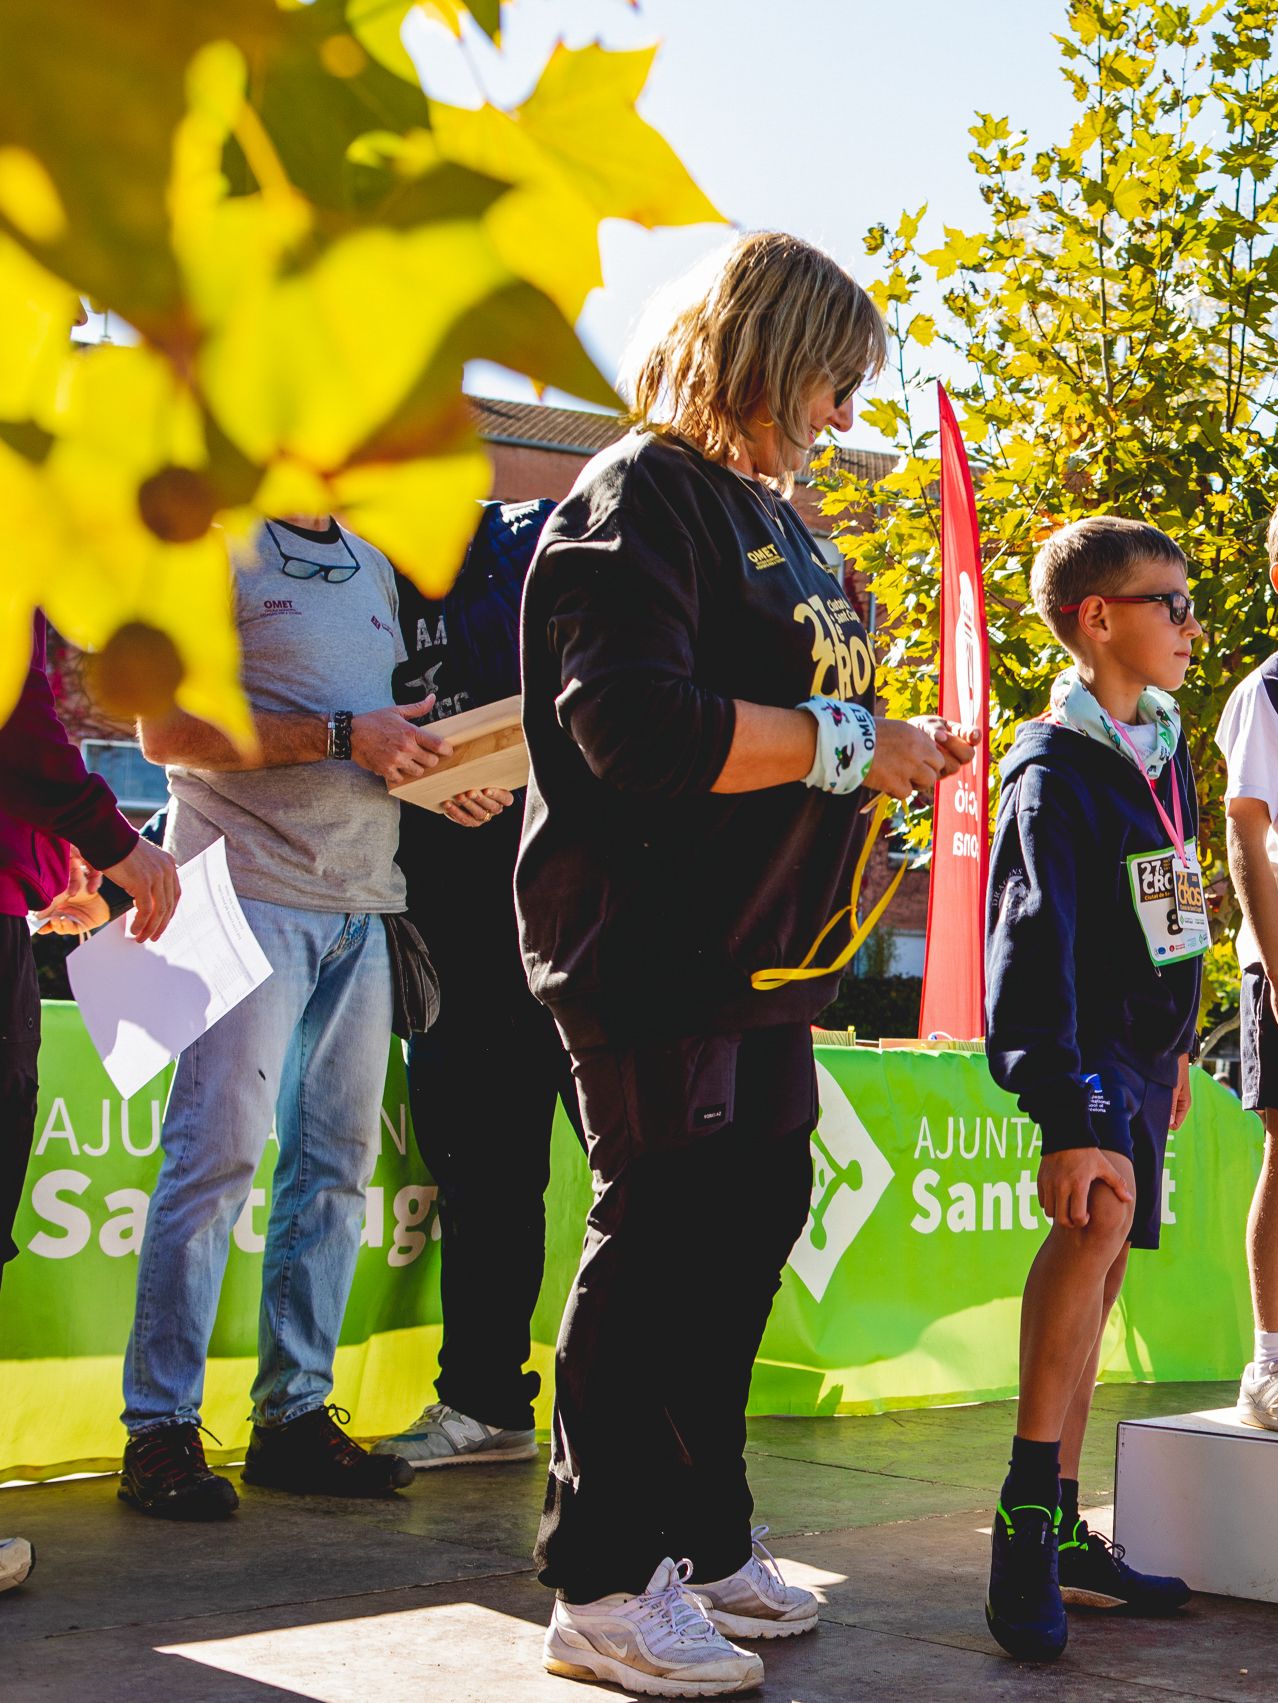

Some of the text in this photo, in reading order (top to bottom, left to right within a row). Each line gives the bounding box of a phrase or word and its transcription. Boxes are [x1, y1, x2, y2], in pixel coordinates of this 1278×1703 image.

[746, 543, 780, 563] OMET
[263, 600, 293, 609] OMET
[1178, 885, 1202, 906] CROS
